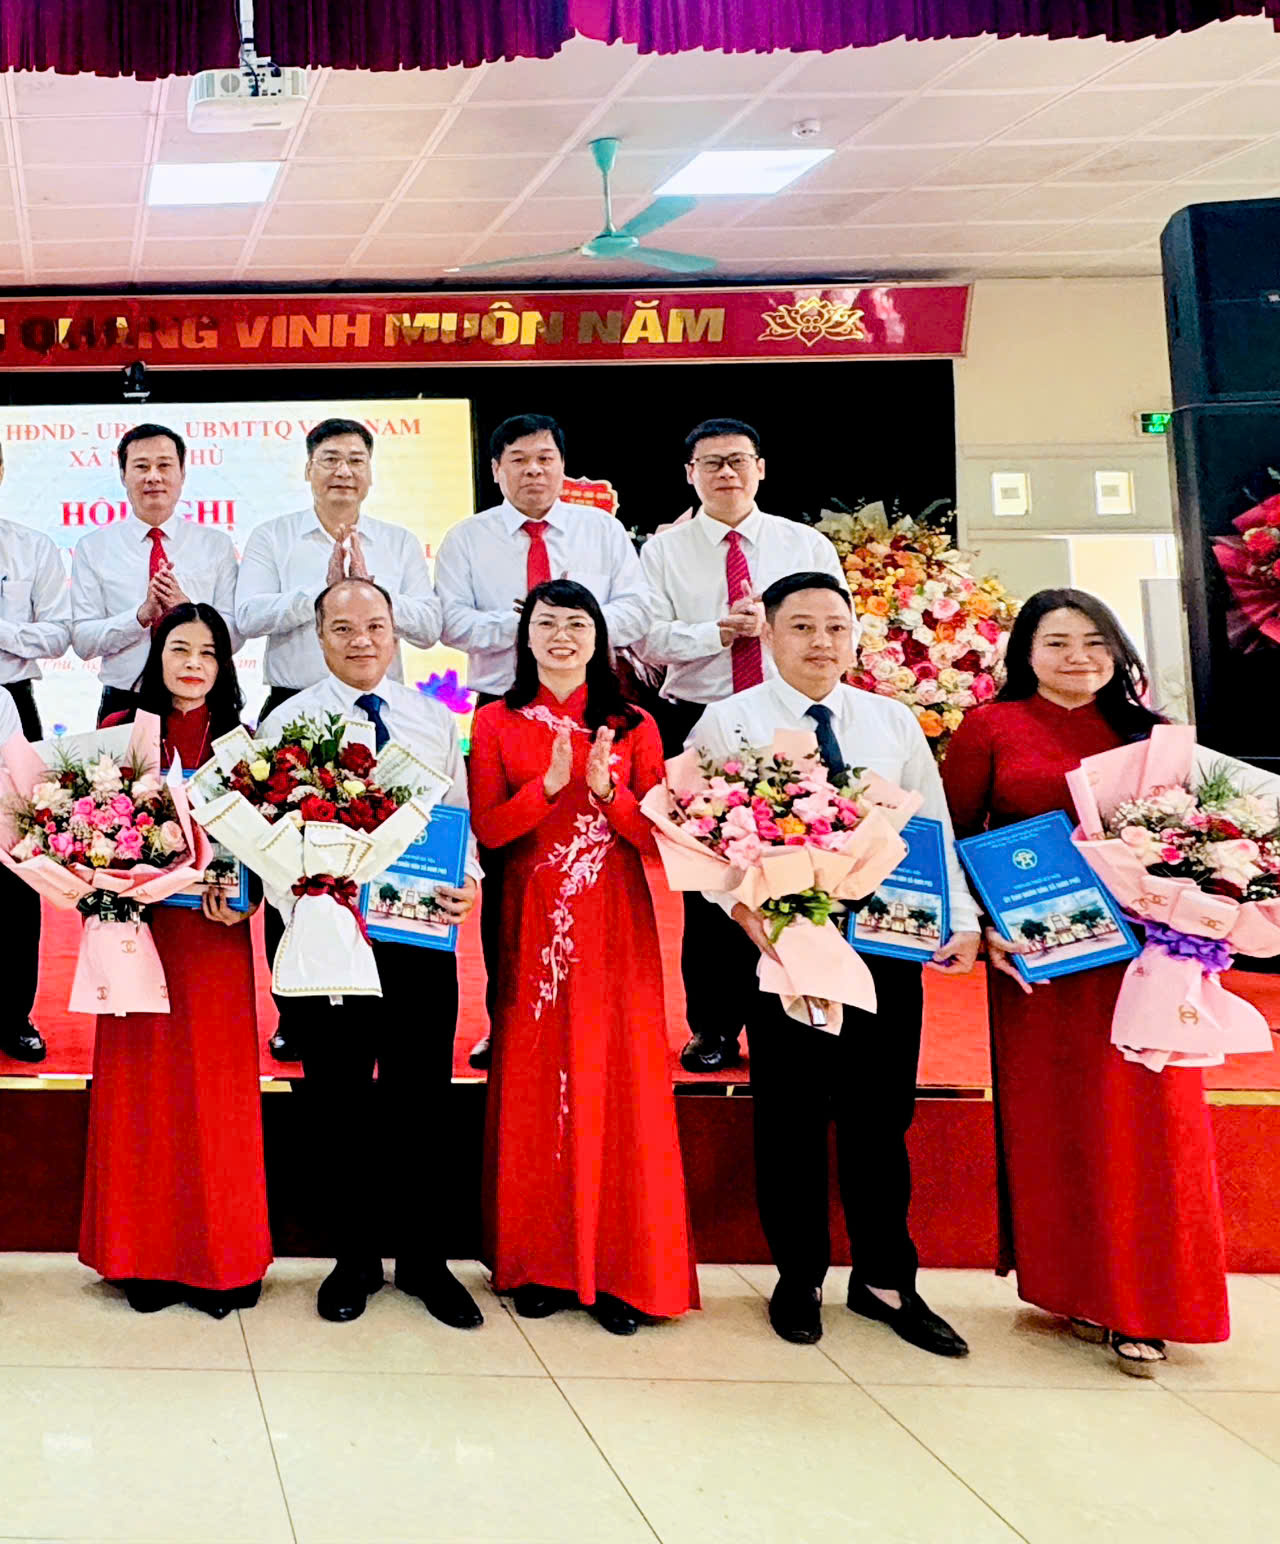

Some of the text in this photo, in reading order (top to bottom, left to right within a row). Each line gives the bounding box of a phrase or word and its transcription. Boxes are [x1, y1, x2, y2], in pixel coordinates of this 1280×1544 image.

[21, 315, 219, 354] QUANG
[236, 313, 371, 349] VINH
[384, 301, 564, 346] MUÔN
[577, 300, 726, 344] NĂM
[6, 423, 75, 441] HĐND
[185, 419, 293, 441] UBMTTQ
[68, 445, 102, 467] XÃ
[188, 443, 224, 466] HÙ
